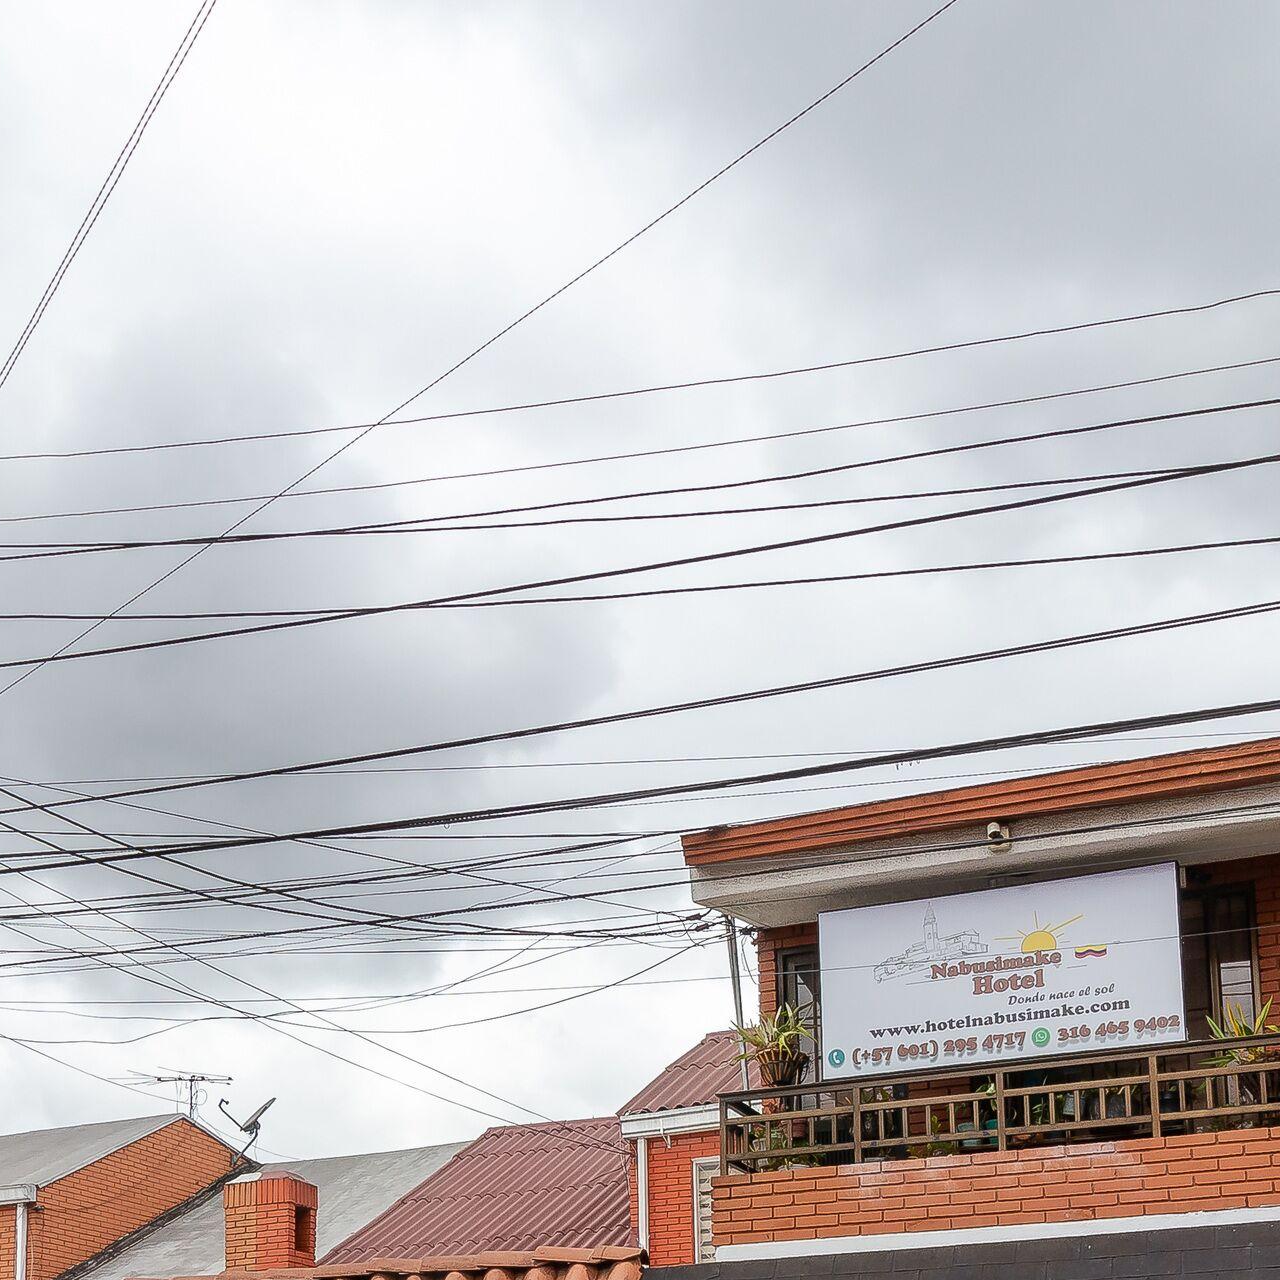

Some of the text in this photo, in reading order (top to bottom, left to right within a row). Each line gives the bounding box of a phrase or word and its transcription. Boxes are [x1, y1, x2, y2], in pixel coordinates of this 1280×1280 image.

[930, 951, 1062, 980] Nabusimake
[972, 969, 1046, 995] Hotel
[1008, 983, 1116, 1006] Donde nace el sol
[869, 1000, 1131, 1039] www.hotelnabusimake.com
[897, 1040, 939, 1057] 601)
[943, 1036, 978, 1052] 295
[981, 1031, 1027, 1049] 4717
[1057, 1025, 1091, 1042] 316
[1094, 1020, 1130, 1037] 465
[1133, 1014, 1181, 1033] 9402
